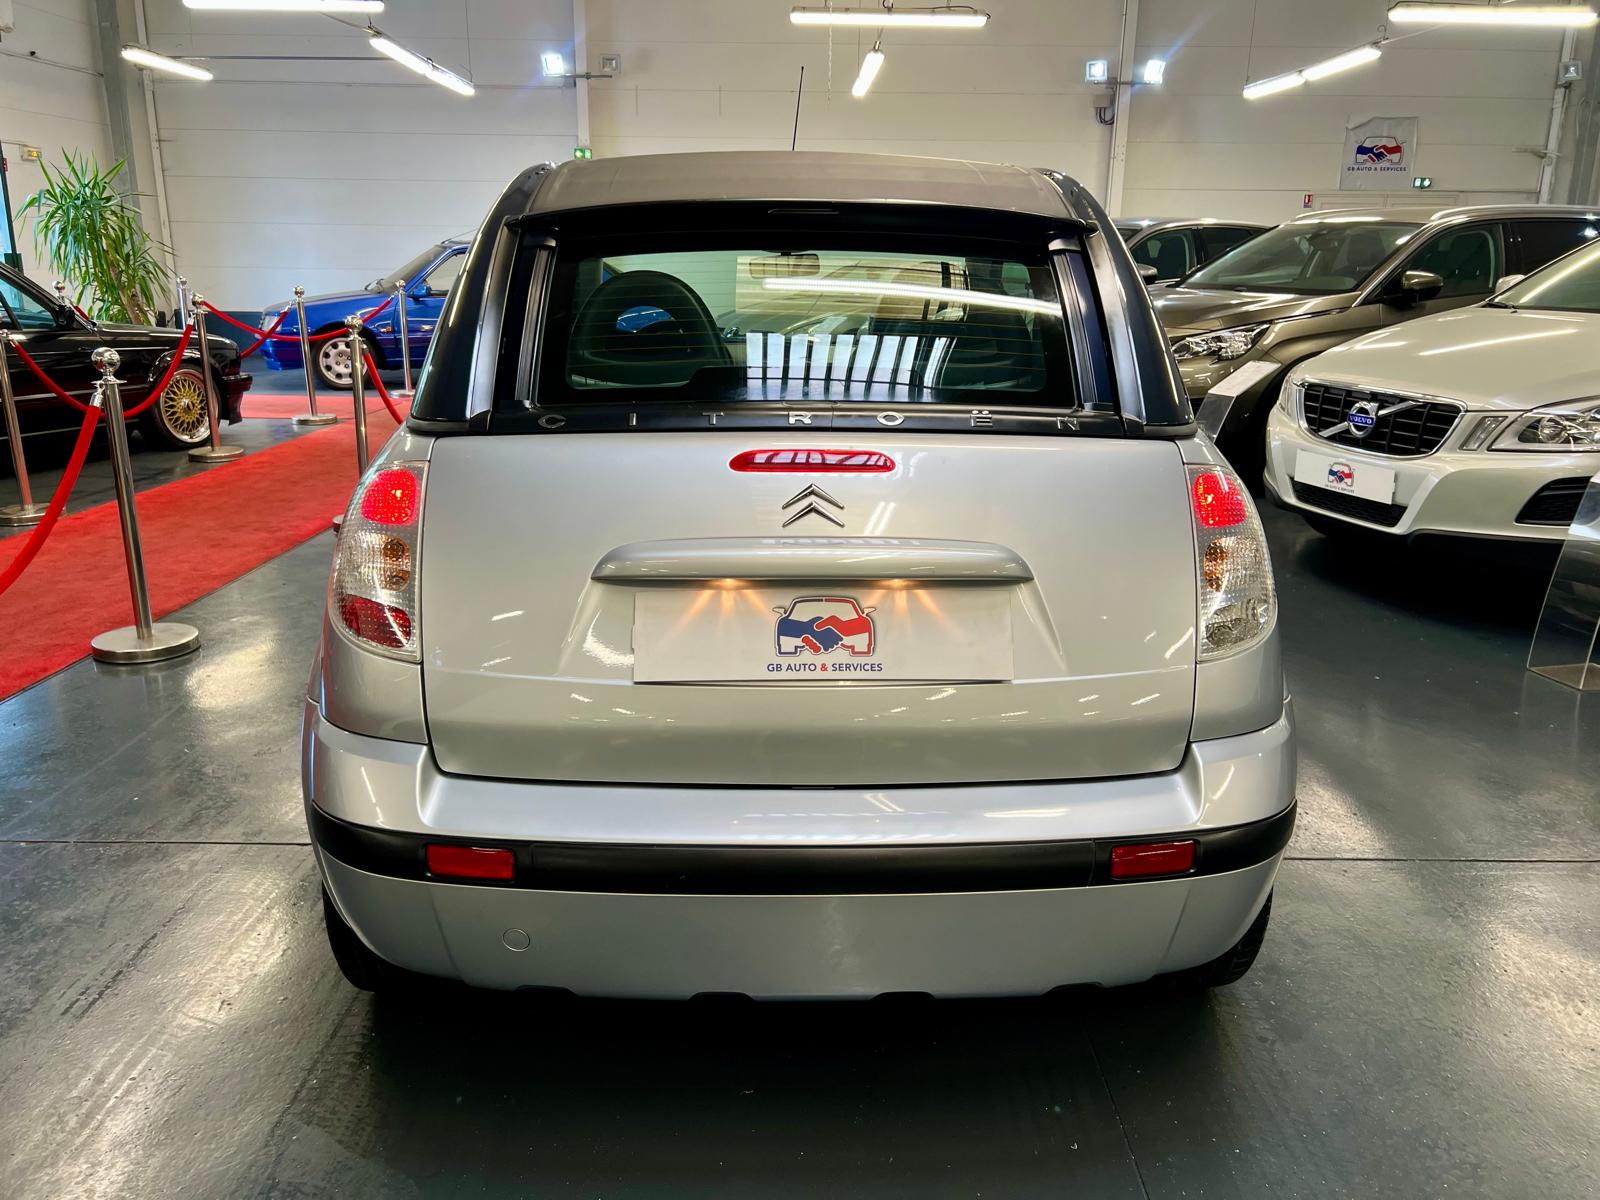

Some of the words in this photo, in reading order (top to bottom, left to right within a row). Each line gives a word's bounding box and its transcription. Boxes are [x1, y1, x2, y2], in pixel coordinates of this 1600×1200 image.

[1350, 415, 1372, 424] VOLVO
[767, 663, 782, 672] GB
[786, 663, 817, 672] AUTO
[820, 663, 829, 672] &
[832, 663, 883, 672] SERVICES
